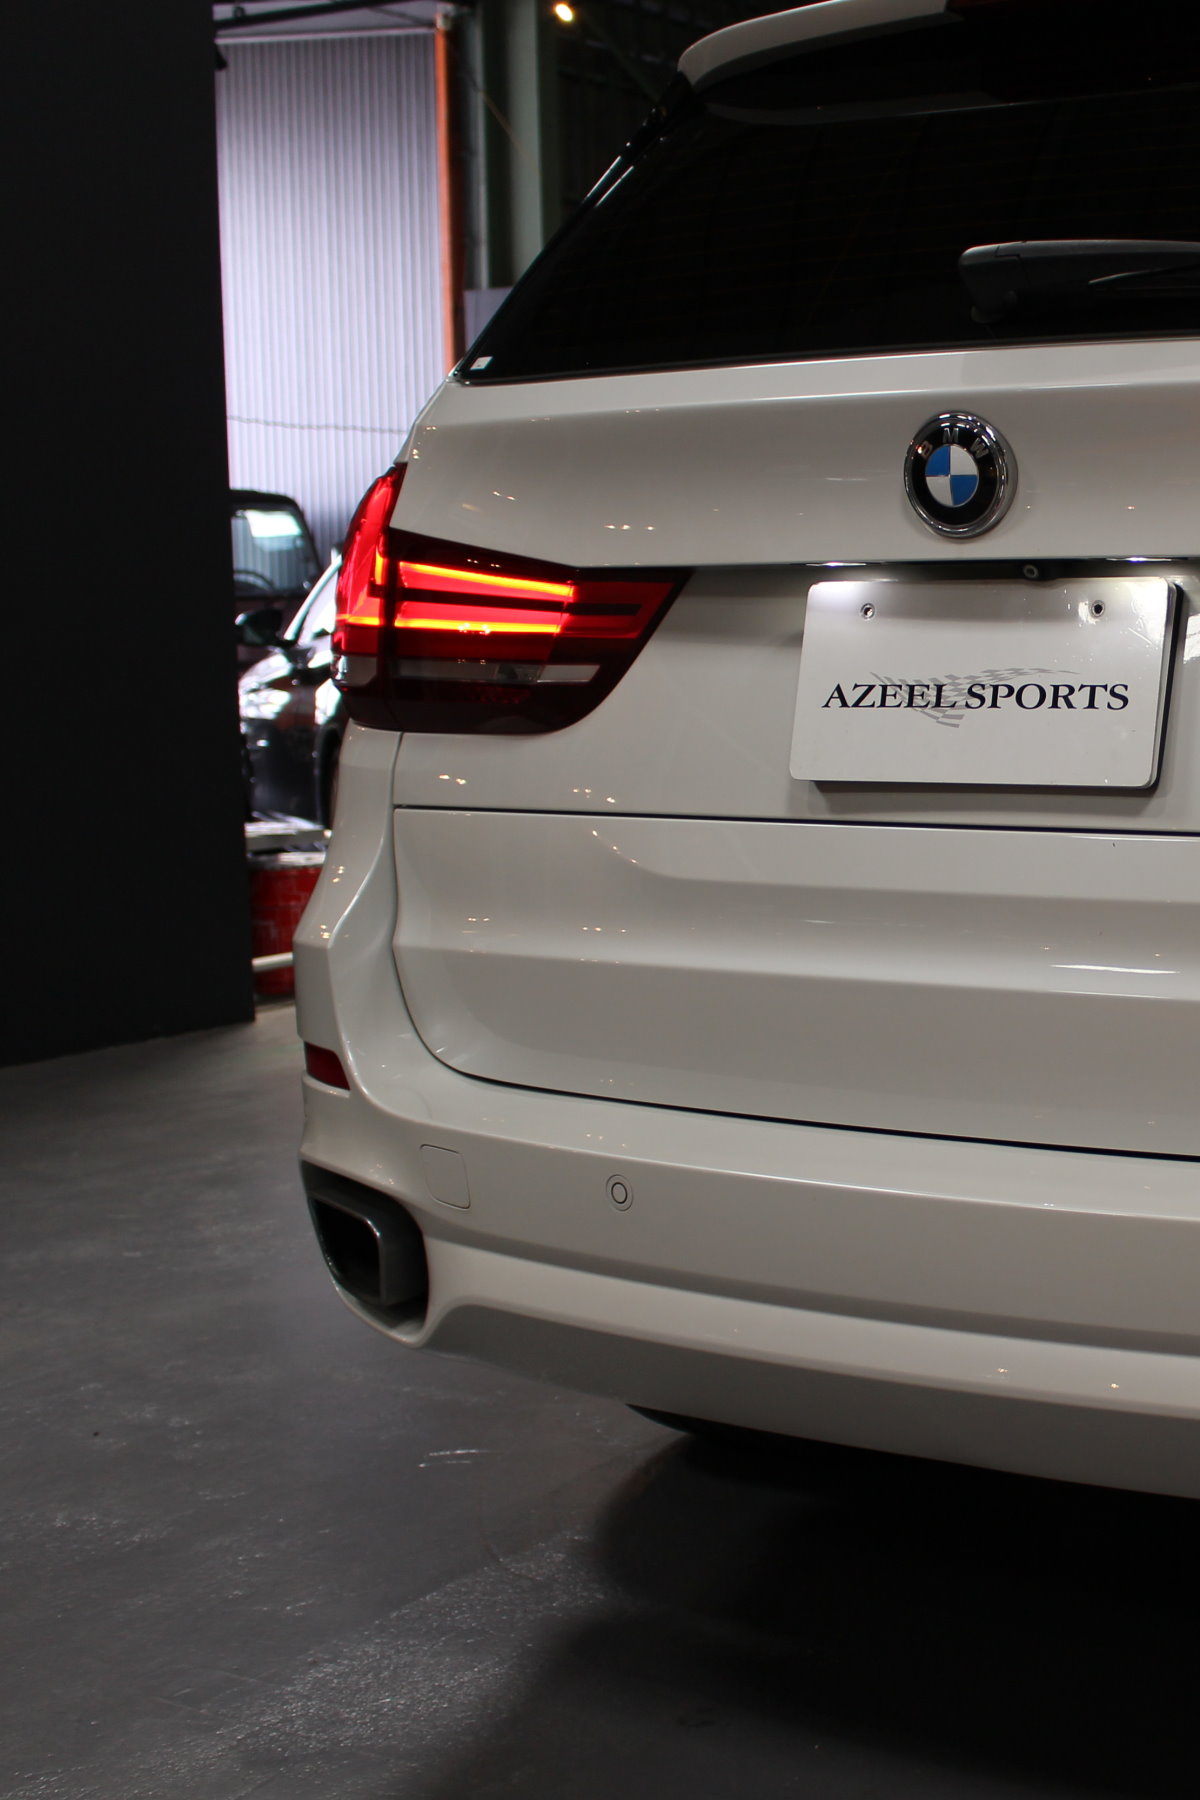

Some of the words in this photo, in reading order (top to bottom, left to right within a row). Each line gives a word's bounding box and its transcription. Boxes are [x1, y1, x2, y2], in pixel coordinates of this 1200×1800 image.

[916, 427, 989, 460] BMW
[821, 682, 960, 710] AZEEL
[964, 682, 1130, 711] SPORTS
